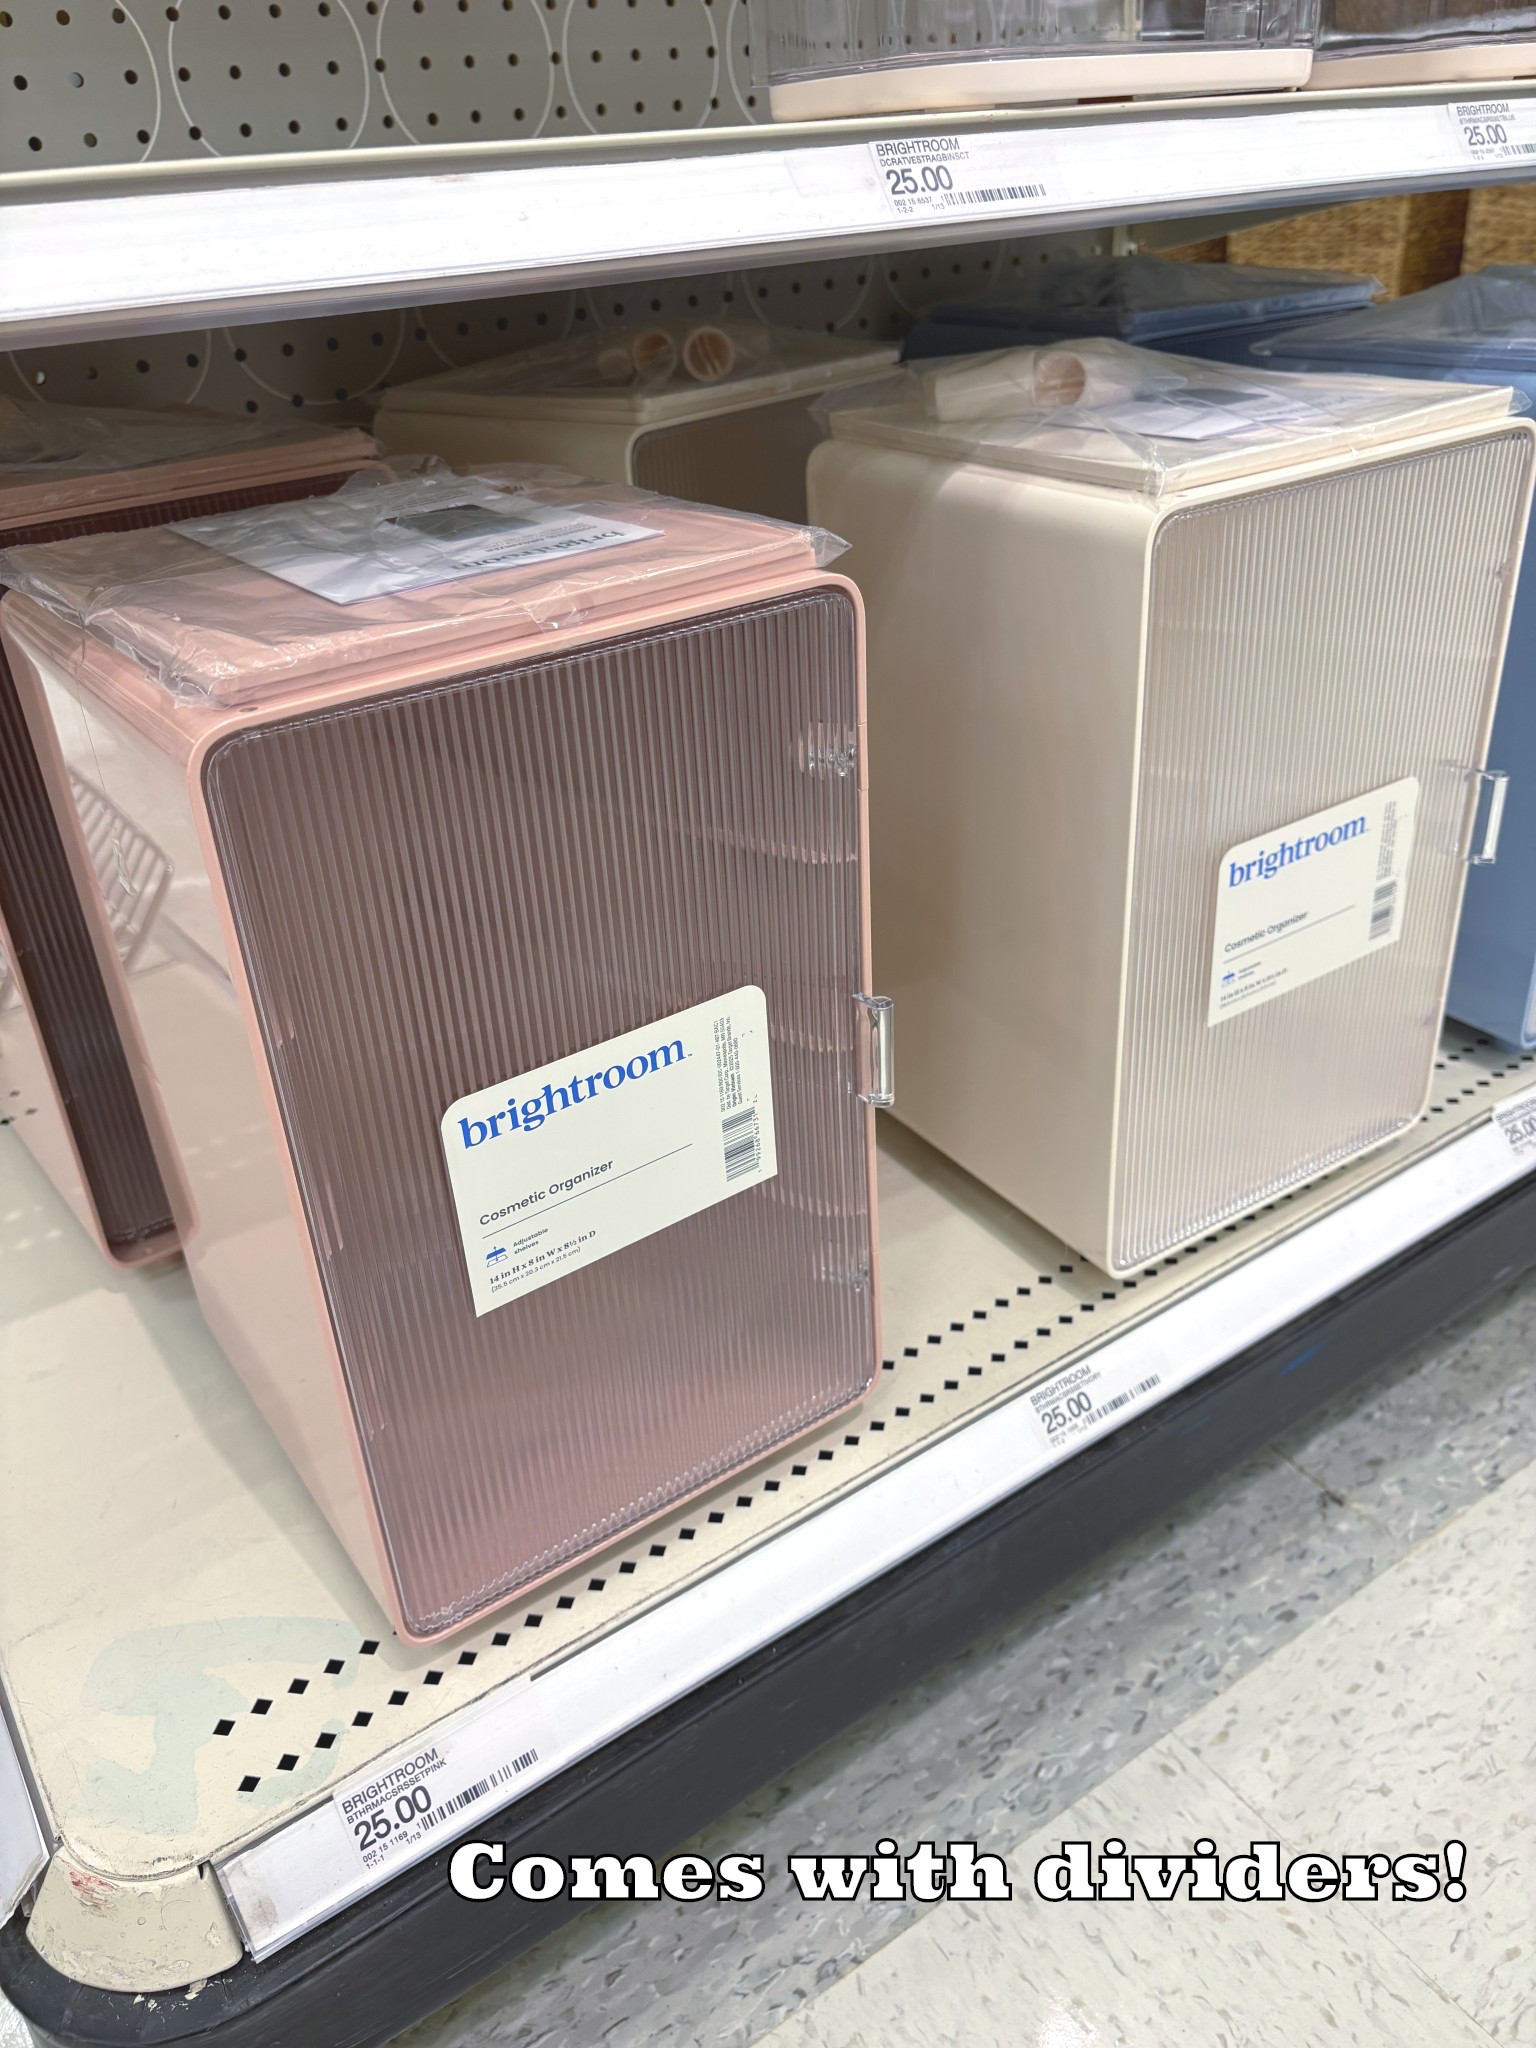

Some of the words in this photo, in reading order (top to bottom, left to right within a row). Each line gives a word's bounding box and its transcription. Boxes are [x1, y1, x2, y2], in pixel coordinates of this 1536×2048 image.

[1456, 102, 1510, 116] BRIGHTROOM
[875, 138, 960, 157] BRIGHTROOM
[1463, 124, 1507, 146] 25.00
[885, 165, 953, 195] 25.00
[1228, 815, 1367, 888] brightroom
[1224, 928, 1266, 953] Cosmetic
[1266, 911, 1309, 936] Organizer
[457, 1039, 688, 1150] brightroom
[479, 1191, 546, 1225] Cosmetic
[548, 1160, 613, 1195] Organizer
[489, 1275, 500, 1285] 14
[501, 1270, 511, 1279] in
[511, 1265, 520, 1274] H
[528, 1258, 535, 1267] 8
[535, 1253, 545, 1263] in
[546, 1248, 556, 1258] W
[556, 1245, 563, 1253] x
[578, 1235, 588, 1243] in
[588, 1230, 596, 1239] D
[513, 1228, 549, 1247] Adjustable
[514, 1240, 539, 1255] shelves
[491, 1281, 508, 1293] (35.5
[508, 1275, 520, 1284] cm
[525, 1267, 539, 1277] 20.3
[539, 1262, 551, 1270] cm
[555, 1253, 568, 1263] 21.5
[568, 1246, 581, 1257] cm)
[1030, 1364, 1092, 1407] BRIGHTROOM
[1041, 1391, 1092, 1435] 25.00
[341, 1747, 439, 1815] BRIGHTROOM
[346, 1758, 447, 1825] BTHRMACSRSSETPINK
[354, 1785, 431, 1852] 25.00
[362, 1852, 378, 1863] 002
[378, 1844, 389, 1853] 15
[389, 1831, 409, 1846] 1169
[365, 1854, 385, 1870] 1-1-1
[405, 1831, 422, 1845] 1/13
